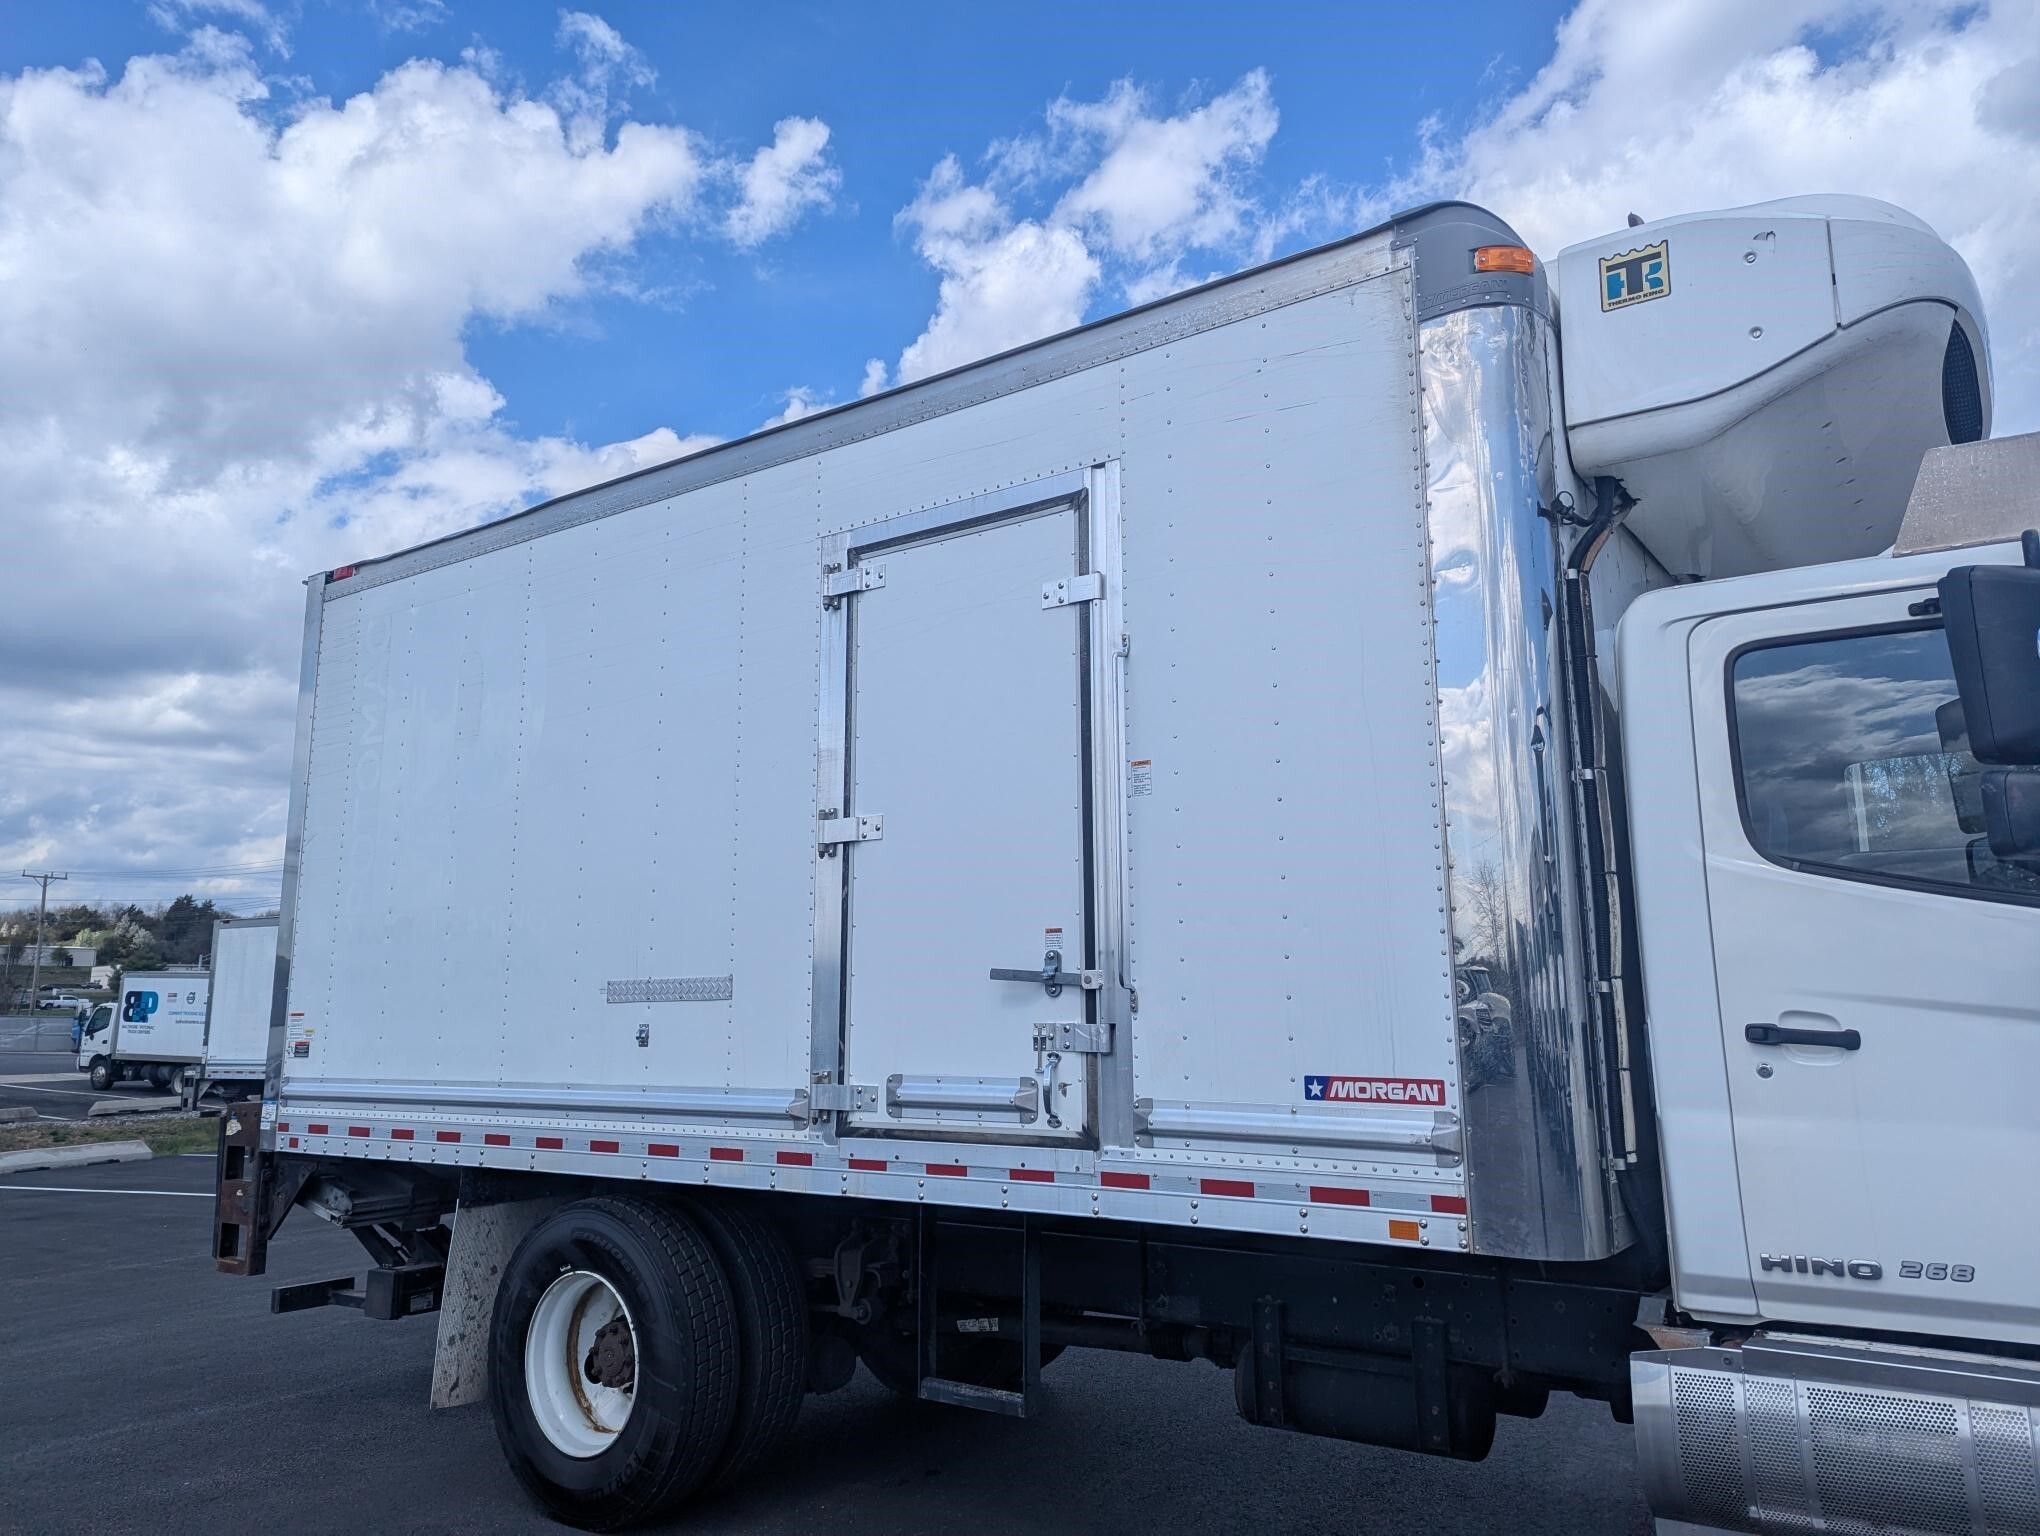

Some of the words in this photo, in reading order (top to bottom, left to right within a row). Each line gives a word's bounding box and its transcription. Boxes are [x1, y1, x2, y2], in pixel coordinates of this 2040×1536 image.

[1607, 294, 1642, 308] THERMO
[1643, 289, 1665, 299] KING
[1329, 1080, 1440, 1102] MORGAN
[1759, 1252, 1883, 1281] HINO
[1898, 1260, 1976, 1283] 268
